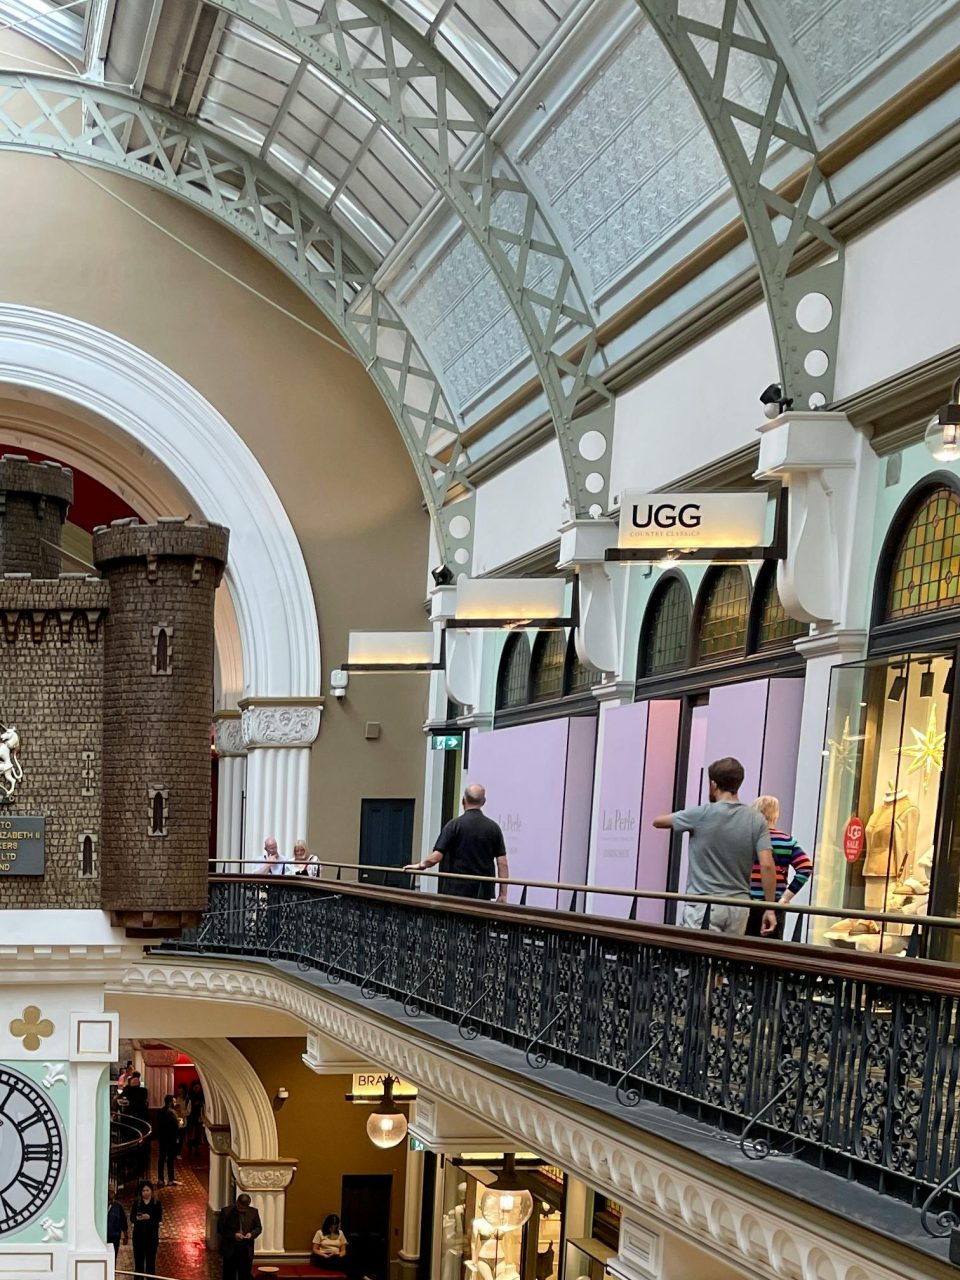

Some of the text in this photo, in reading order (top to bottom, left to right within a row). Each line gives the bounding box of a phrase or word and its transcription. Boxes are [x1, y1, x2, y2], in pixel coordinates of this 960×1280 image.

[632, 503, 702, 528] UGG
[0, 821, 12, 829] TO
[602, 809, 635, 831] La Perle
[847, 825, 861, 839] UGG
[1, 852, 16, 860] LTD
[358, 1075, 401, 1086] BRAA
